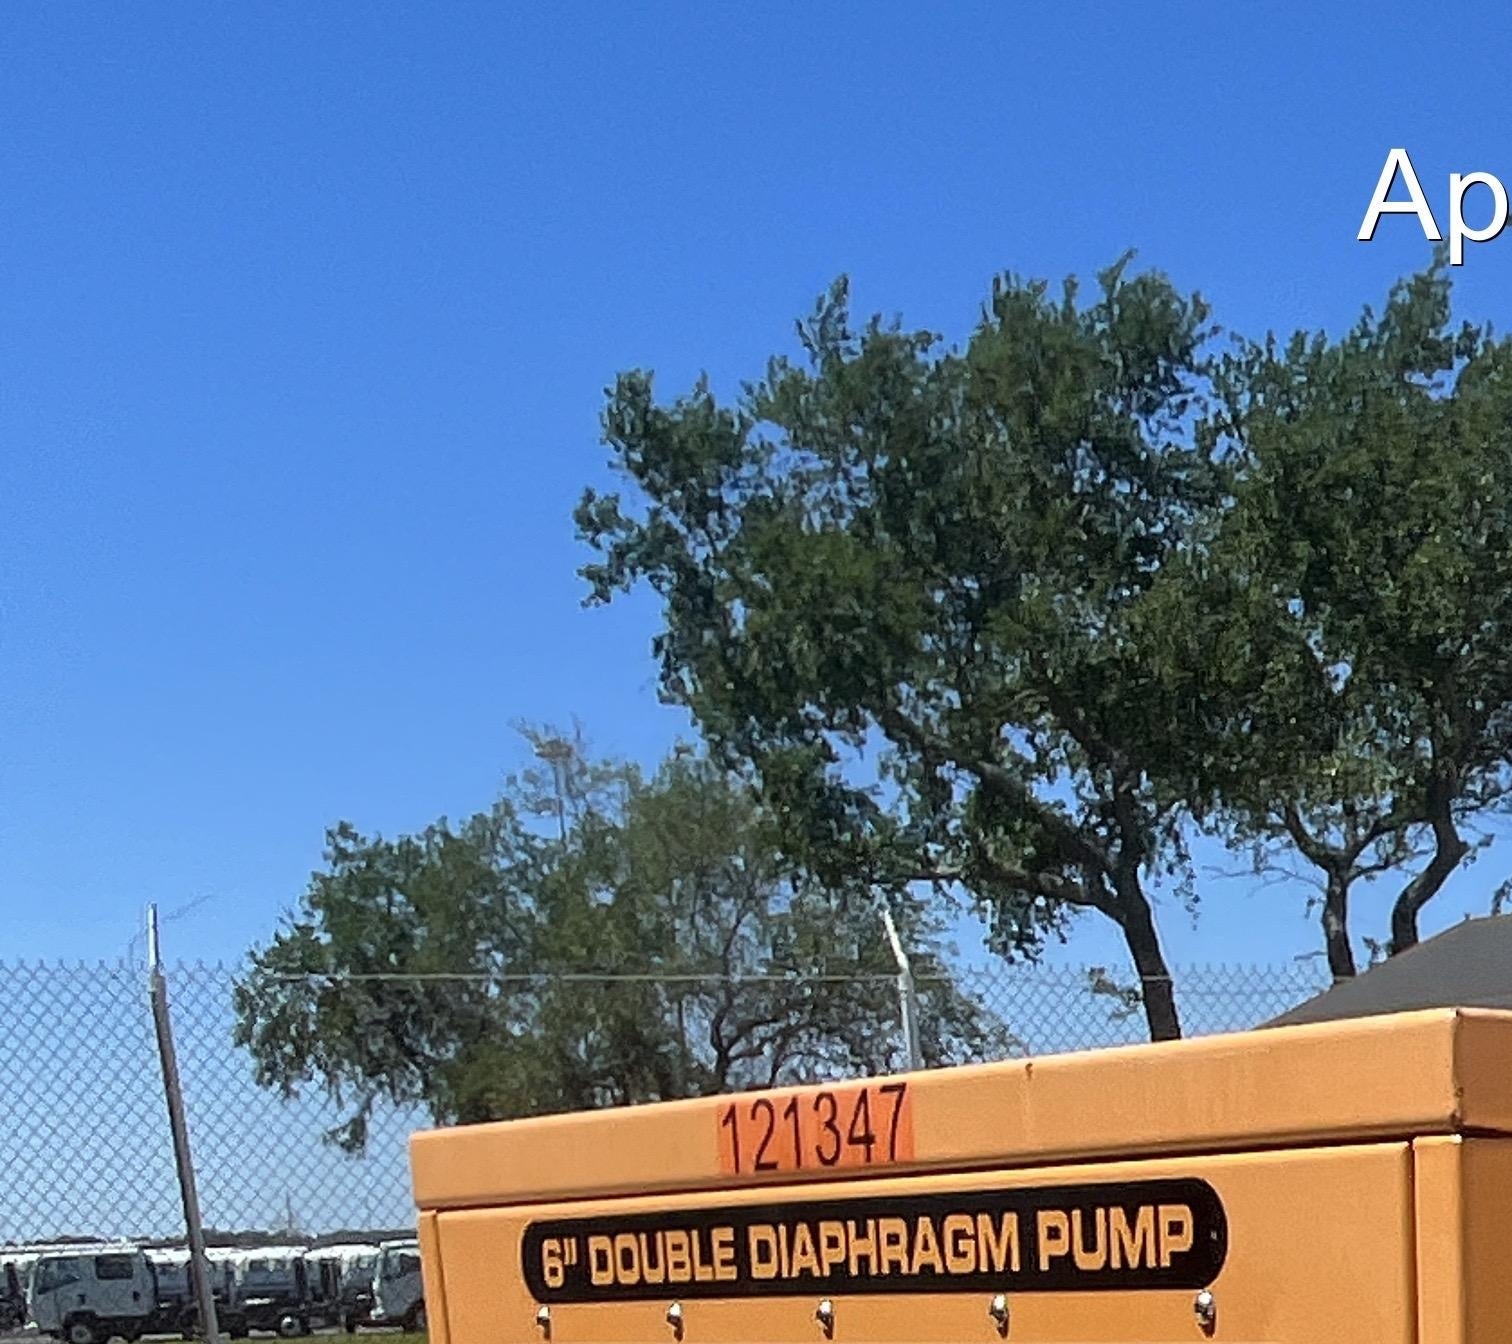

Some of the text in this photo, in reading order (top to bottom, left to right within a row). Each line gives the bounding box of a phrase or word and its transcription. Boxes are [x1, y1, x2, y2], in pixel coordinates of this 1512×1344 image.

[721, 1081, 907, 1175] 121347
[589, 1226, 738, 1284] DOUBLE
[748, 1212, 1020, 1278] DIAPHRAGM
[1037, 1203, 1195, 1271] PUMP
